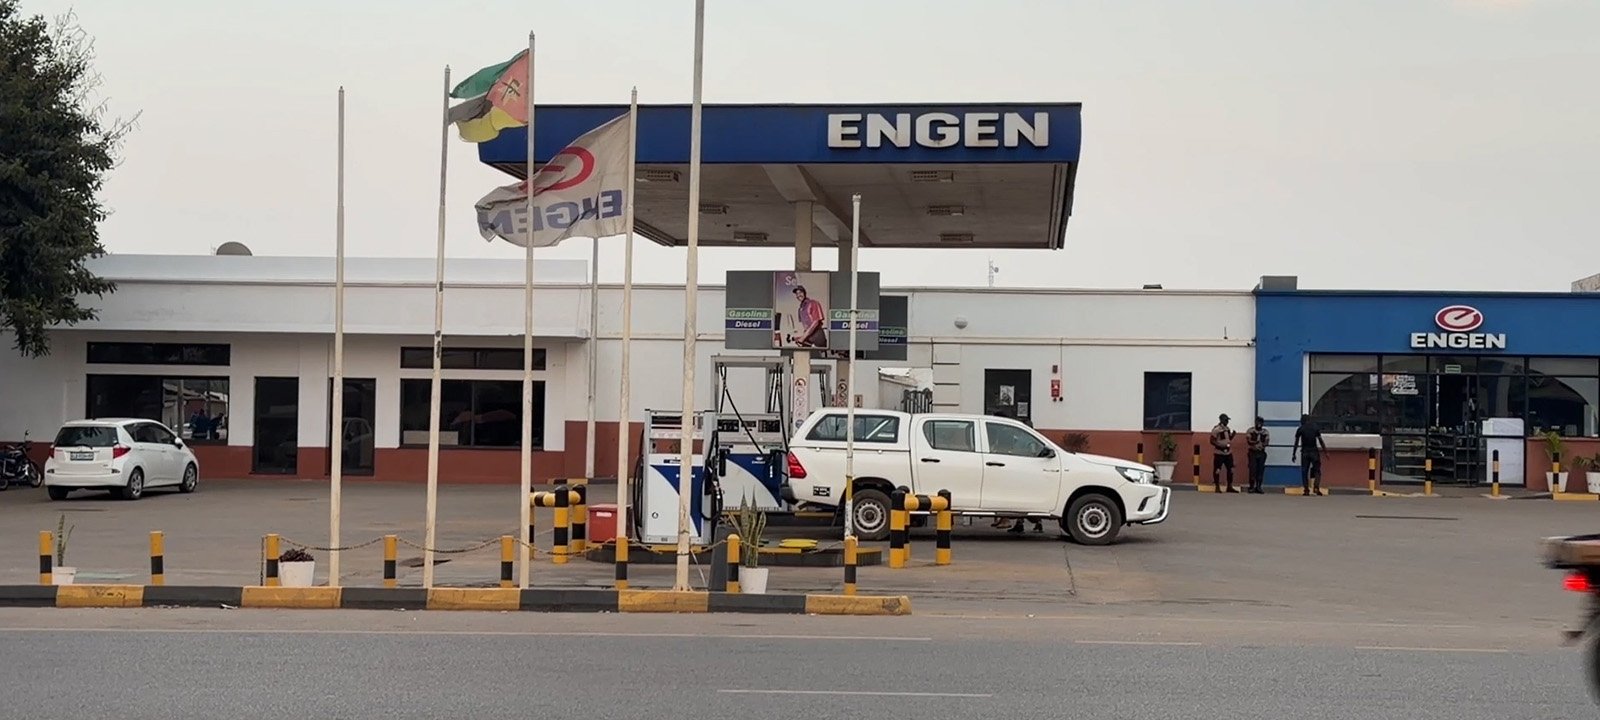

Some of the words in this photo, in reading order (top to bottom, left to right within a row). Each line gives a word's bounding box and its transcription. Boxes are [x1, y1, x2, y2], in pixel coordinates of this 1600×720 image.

[827, 112, 1049, 148] ENGEN
[729, 309, 768, 318] Gasolina
[735, 320, 761, 328] Diesel
[1410, 332, 1506, 349] ENGEN
